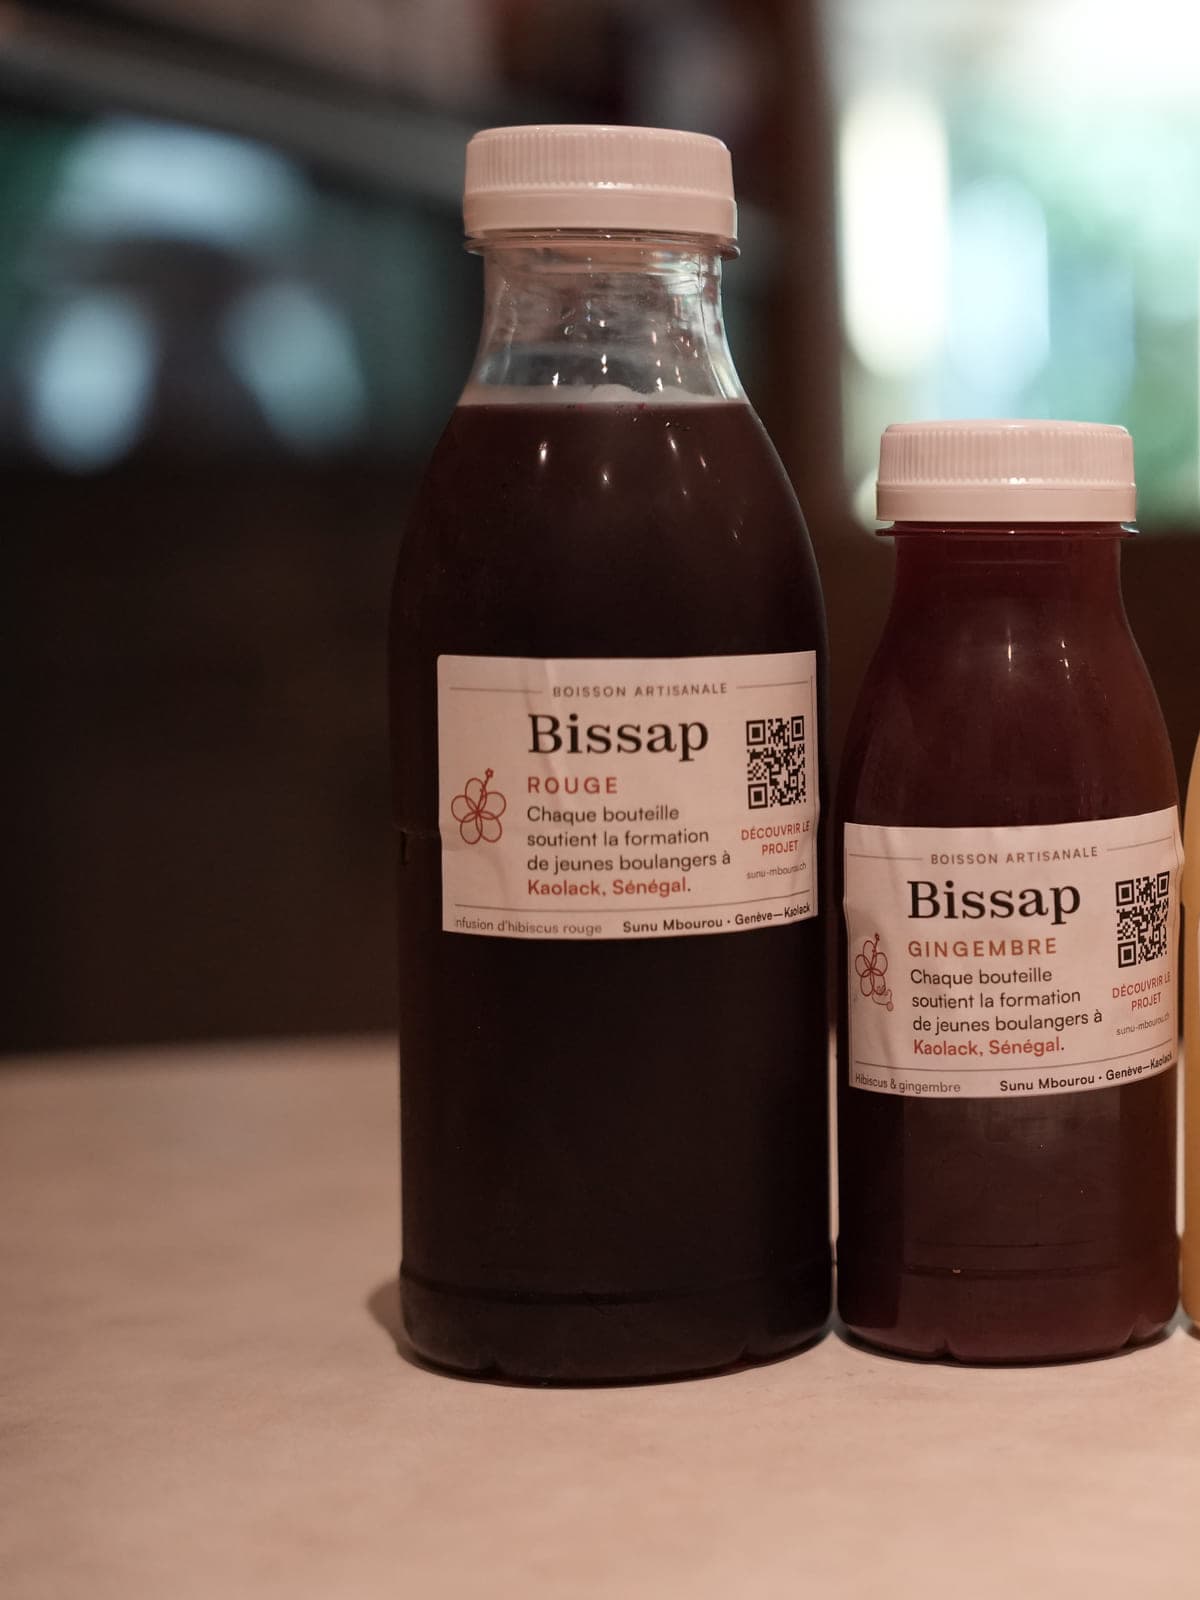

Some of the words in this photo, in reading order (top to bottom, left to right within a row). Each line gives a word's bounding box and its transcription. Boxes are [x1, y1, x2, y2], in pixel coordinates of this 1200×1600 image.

[552, 686, 626, 698] BOISSON
[635, 683, 726, 696] ARTISANALE
[528, 713, 708, 762] Bissap
[528, 776, 617, 795] ROUGE
[527, 806, 596, 826] Chaque
[603, 807, 679, 822] bouteille
[528, 832, 597, 847] soutient
[604, 831, 618, 846] la
[625, 828, 709, 846] formation
[741, 823, 800, 841] DÉCOUVRIR
[802, 820, 810, 833] LE
[762, 840, 798, 856] PROJET
[931, 853, 998, 865] BOISSON
[1006, 846, 1098, 863] ARTISANALE
[527, 855, 547, 871] de
[553, 856, 613, 875] jeunes
[620, 852, 717, 875] boulangers
[722, 850, 730, 864] à
[528, 880, 606, 896] Kaolack,
[613, 878, 691, 898] Sénégal.
[907, 880, 1080, 925] Bissap
[455, 916, 494, 929] nfusion
[563, 924, 602, 936] rouge
[623, 921, 657, 933] Sunu
[663, 917, 722, 931] Mbourou
[908, 937, 1056, 957] GINGEMBRE
[911, 969, 973, 989] Chaque
[979, 967, 1052, 984] bouteille
[1112, 977, 1163, 998] DÉCOUVRIR
[1164, 972, 1171, 983] LE
[912, 994, 974, 1009] soutient
[980, 992, 994, 1008] la
[1000, 989, 1080, 1007] formation
[1132, 992, 1161, 1012] PROJET
[913, 1016, 931, 1031] de
[935, 1016, 990, 1036] jeunes
[996, 1012, 1088, 1034] boulangers
[1094, 1009, 1102, 1023] à
[914, 1039, 983, 1056] Kaolack,
[989, 1036, 1064, 1057] Sénégal.
[855, 1074, 888, 1090] Hibiscus
[890, 1078, 897, 1089] &
[898, 1080, 960, 1094] gingembre
[1000, 1080, 1033, 1091] Sunu
[1039, 1075, 1094, 1089] Mbourou
